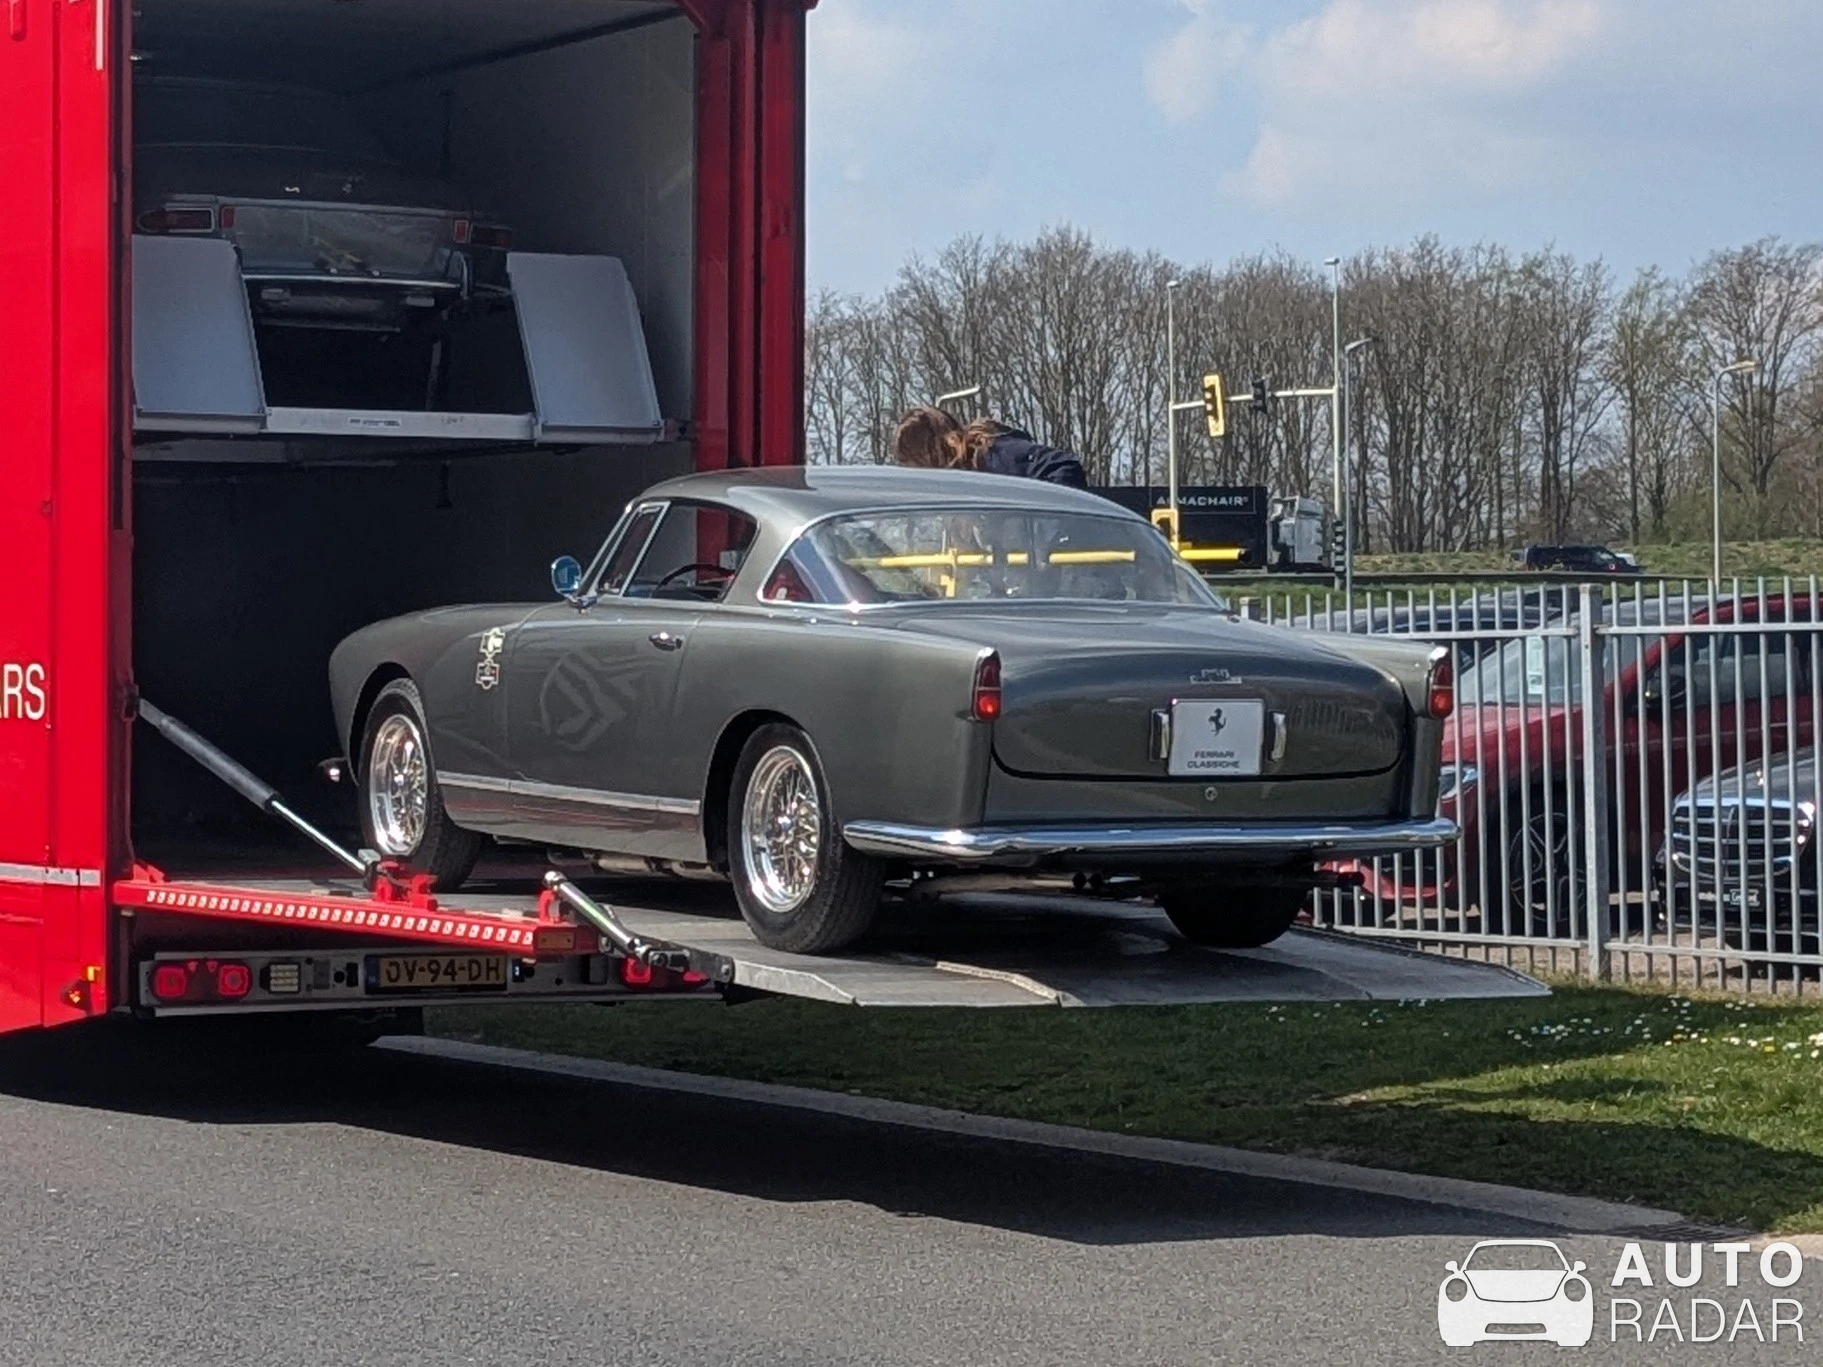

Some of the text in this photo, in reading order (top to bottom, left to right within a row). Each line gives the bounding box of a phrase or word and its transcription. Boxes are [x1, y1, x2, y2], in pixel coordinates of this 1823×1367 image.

[0, 663, 46, 720] RS
[1194, 750, 1235, 759] FERRARI
[1187, 760, 1240, 769] CLASSICHE
